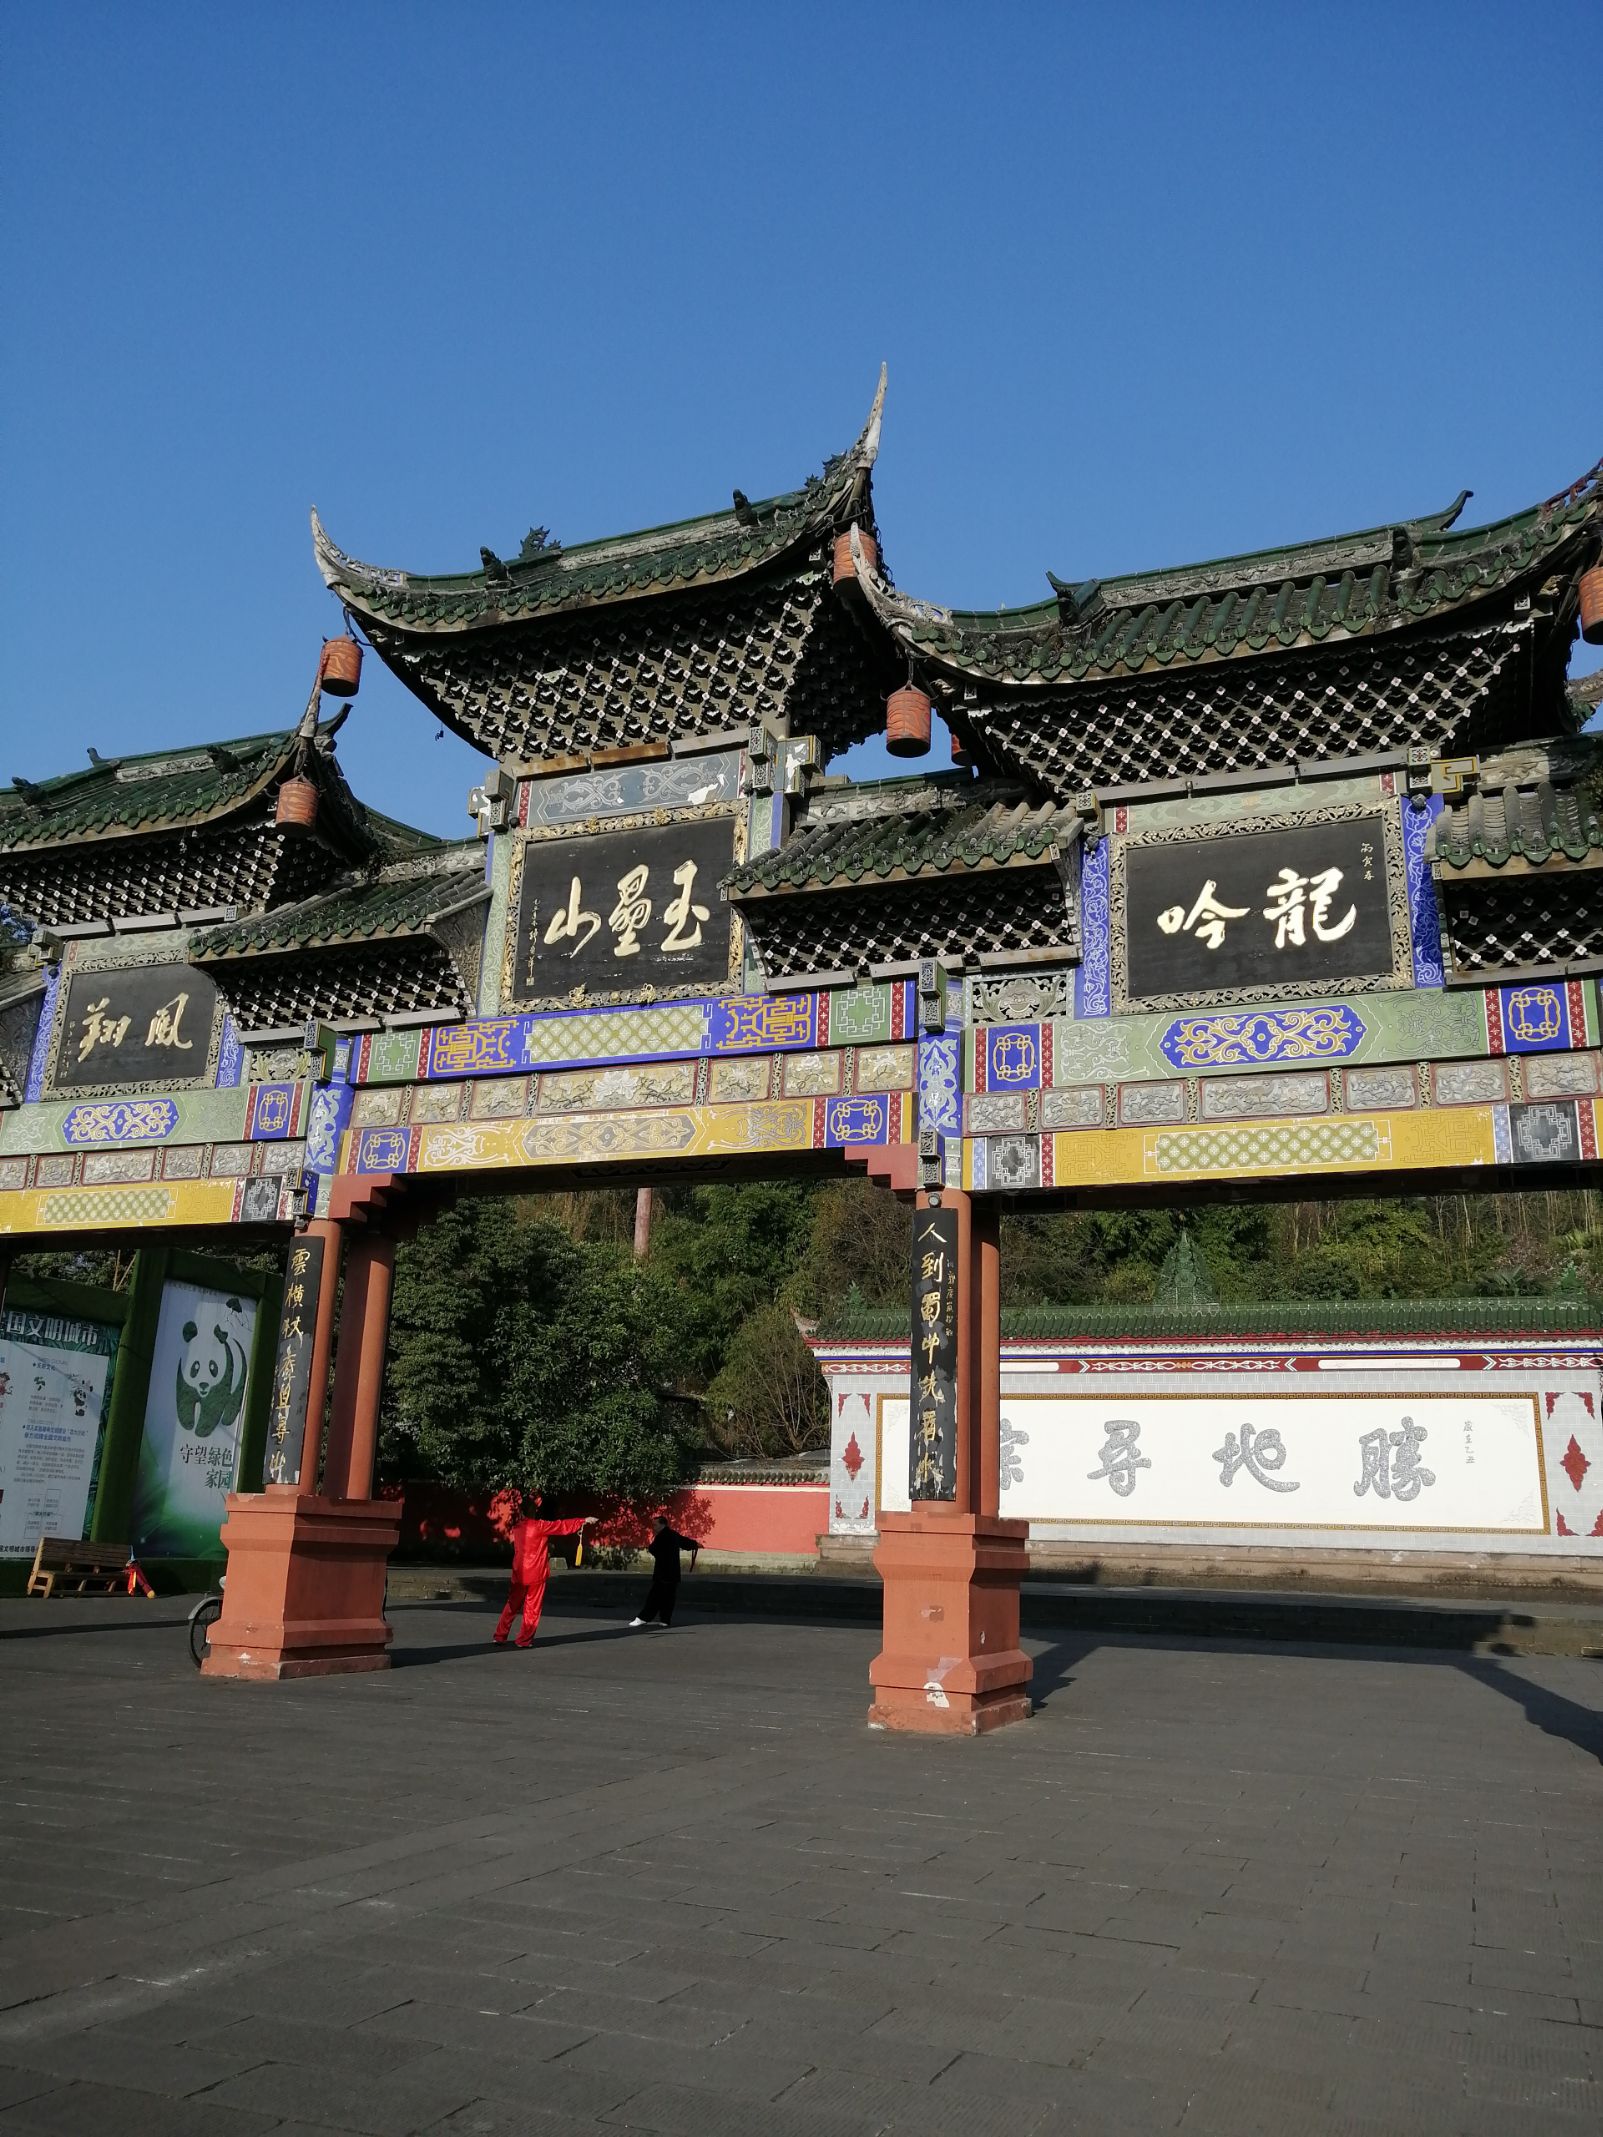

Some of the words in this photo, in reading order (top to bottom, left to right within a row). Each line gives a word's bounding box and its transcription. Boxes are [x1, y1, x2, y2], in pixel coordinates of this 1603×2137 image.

[180, 1443, 233, 1468] 守望绿色
[205, 1469, 232, 1489] 家园
